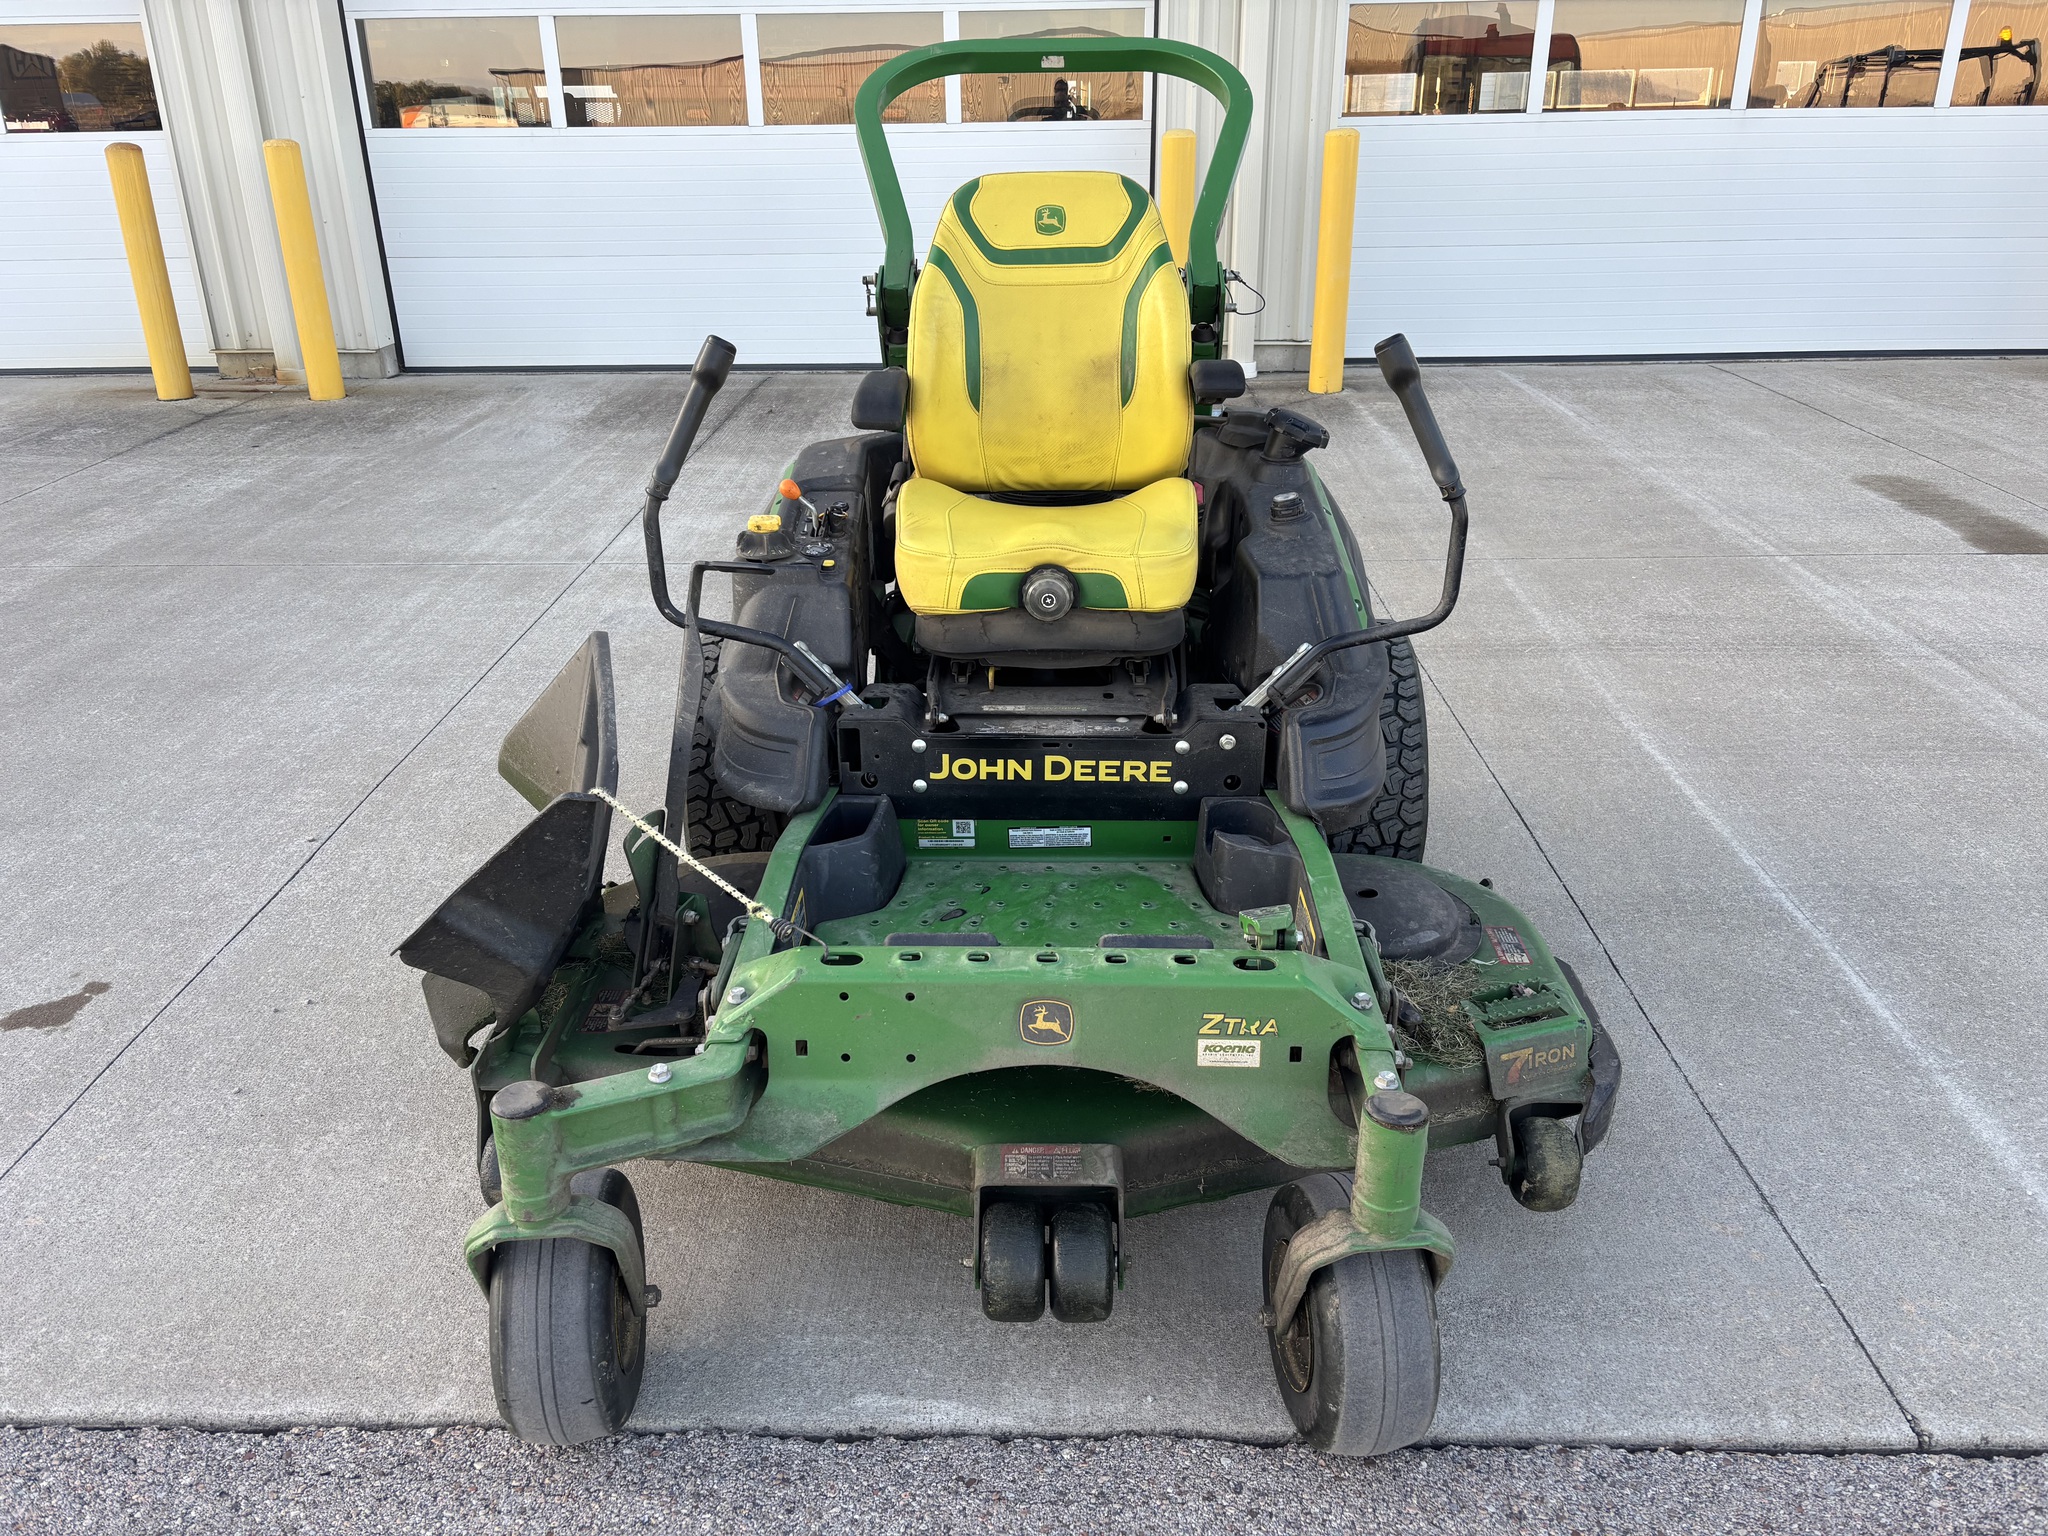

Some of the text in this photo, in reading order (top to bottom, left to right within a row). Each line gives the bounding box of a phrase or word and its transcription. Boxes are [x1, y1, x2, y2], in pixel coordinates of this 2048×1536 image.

[9, 49, 54, 78] CAT
[929, 753, 1173, 783] JOHN DEERE
